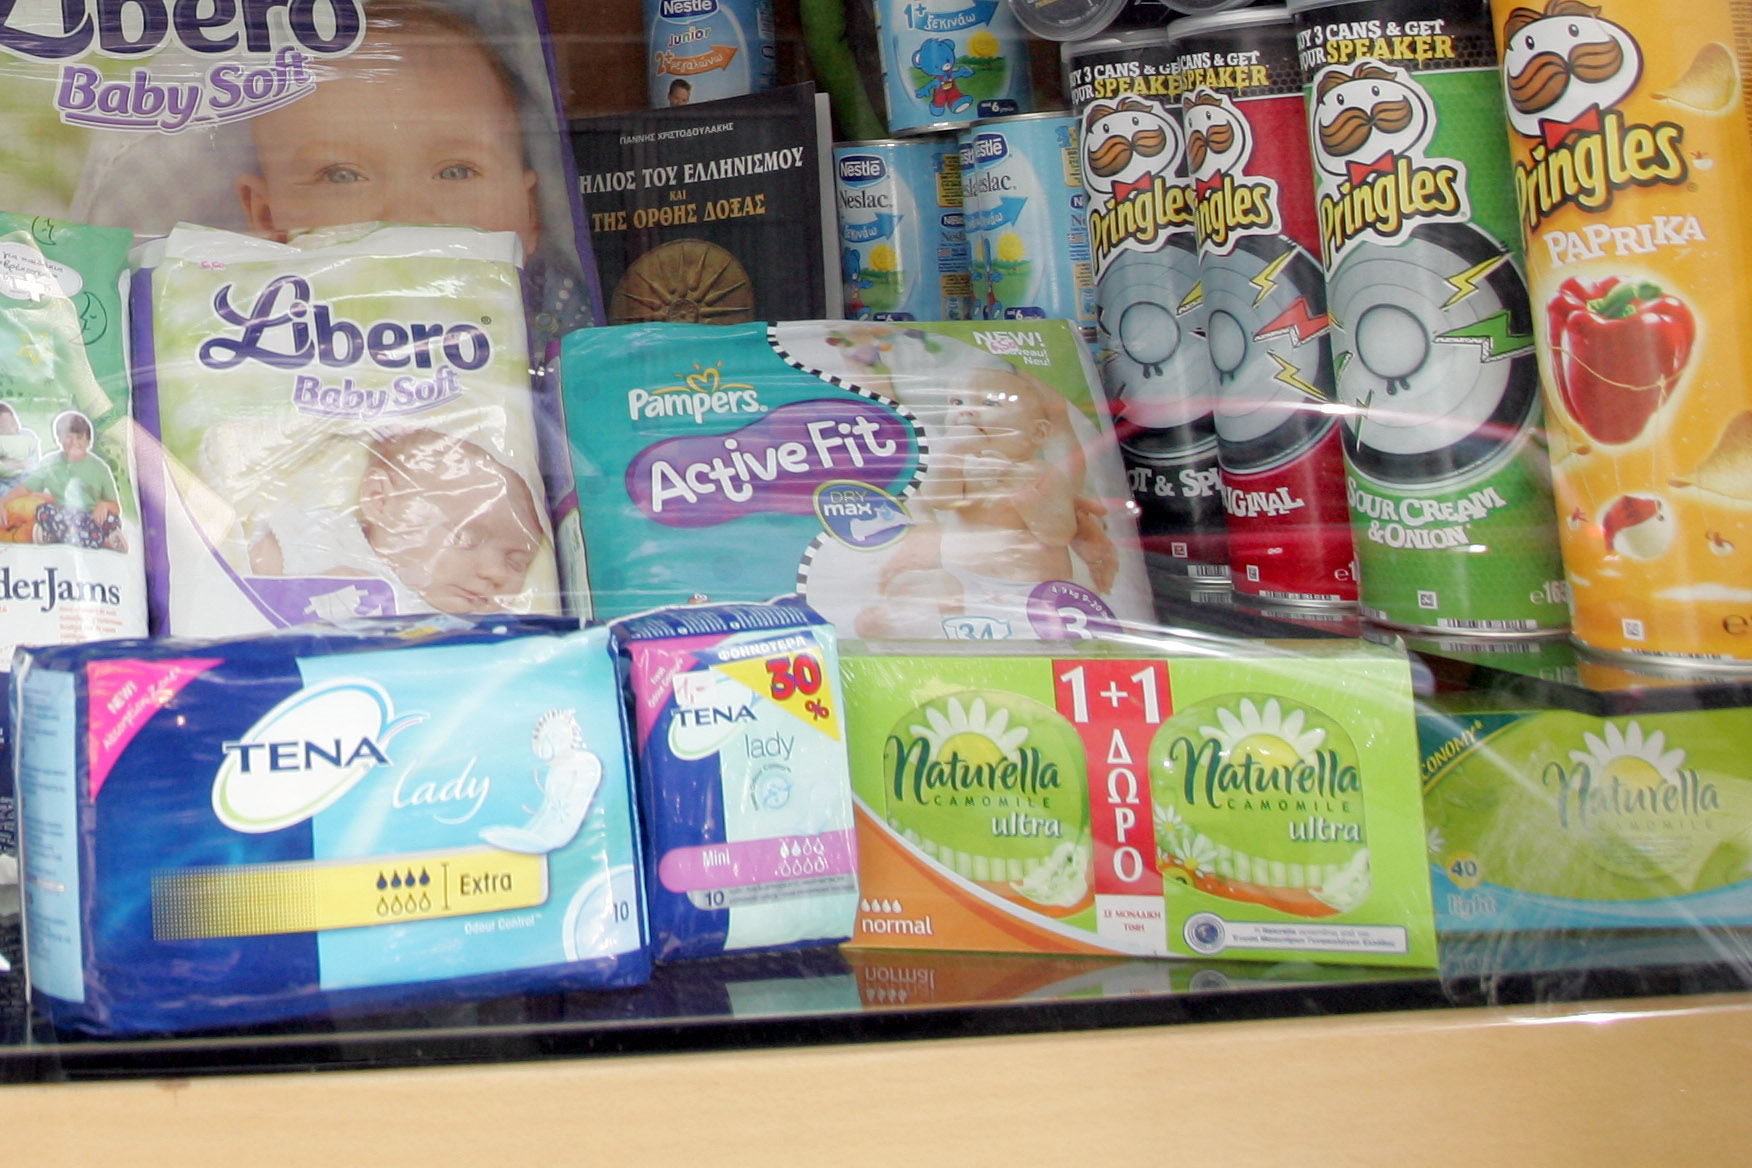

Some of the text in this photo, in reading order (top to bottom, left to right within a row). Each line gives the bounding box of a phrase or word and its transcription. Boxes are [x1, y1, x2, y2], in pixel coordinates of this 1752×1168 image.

[903, 3, 928, 31] 1+
[1326, 18, 1445, 44] CANS & GET
[1213, 56, 1225, 66] &
[1227, 50, 1260, 65] GET
[1326, 36, 1455, 64] SPEAKER
[1094, 61, 1156, 79] CANS &
[59, 46, 313, 129] Baby Soft
[619, 121, 735, 145] ΓΙΑΝΝΗΣ ΧΡΙΣΤΟΔΟΥΛΑΚΗΣ
[579, 146, 805, 195] ΗΛΙΟΣ ΤΟΥ ΕΛΛΗΝΙΣΜΟΥ
[1516, 119, 1686, 232] Pringles
[668, 188, 687, 202] ΚΑΙ
[839, 189, 891, 210] Neslac
[1320, 156, 1457, 251] Pringles
[592, 193, 767, 234] ΤΗΣ ΟΡΘΗΣ ΔΟΞΑΣ
[1543, 215, 1706, 269] PAPRIKA
[198, 275, 491, 371] Libero
[972, 331, 1045, 348] NEW!
[294, 367, 463, 415] Baby Soft
[628, 384, 761, 424] Pampers
[650, 412, 897, 513] Active Fit
[829, 489, 869, 503] DRY
[1154, 476, 1176, 497] &
[823, 499, 872, 518] max
[1398, 488, 1506, 525] CREAM
[765, 654, 823, 701] 30
[672, 705, 758, 728] TENA
[804, 698, 830, 721] %
[223, 738, 392, 773] TENA
[744, 731, 796, 762] lady
[886, 735, 1060, 806] Naturella
[1169, 736, 1360, 809] Naturella
[934, 795, 1051, 809] CAMOMILE
[1226, 798, 1350, 813] CAMOMILE
[1542, 761, 1721, 830] Naturella
[991, 811, 1063, 838] ultra
[1288, 817, 1362, 843] ultra
[701, 850, 732, 868] Mini
[1450, 860, 1478, 877] 40
[459, 872, 514, 897] Extra
[704, 890, 726, 908] 10
[612, 902, 630, 924] 10
[861, 915, 933, 936] normal
